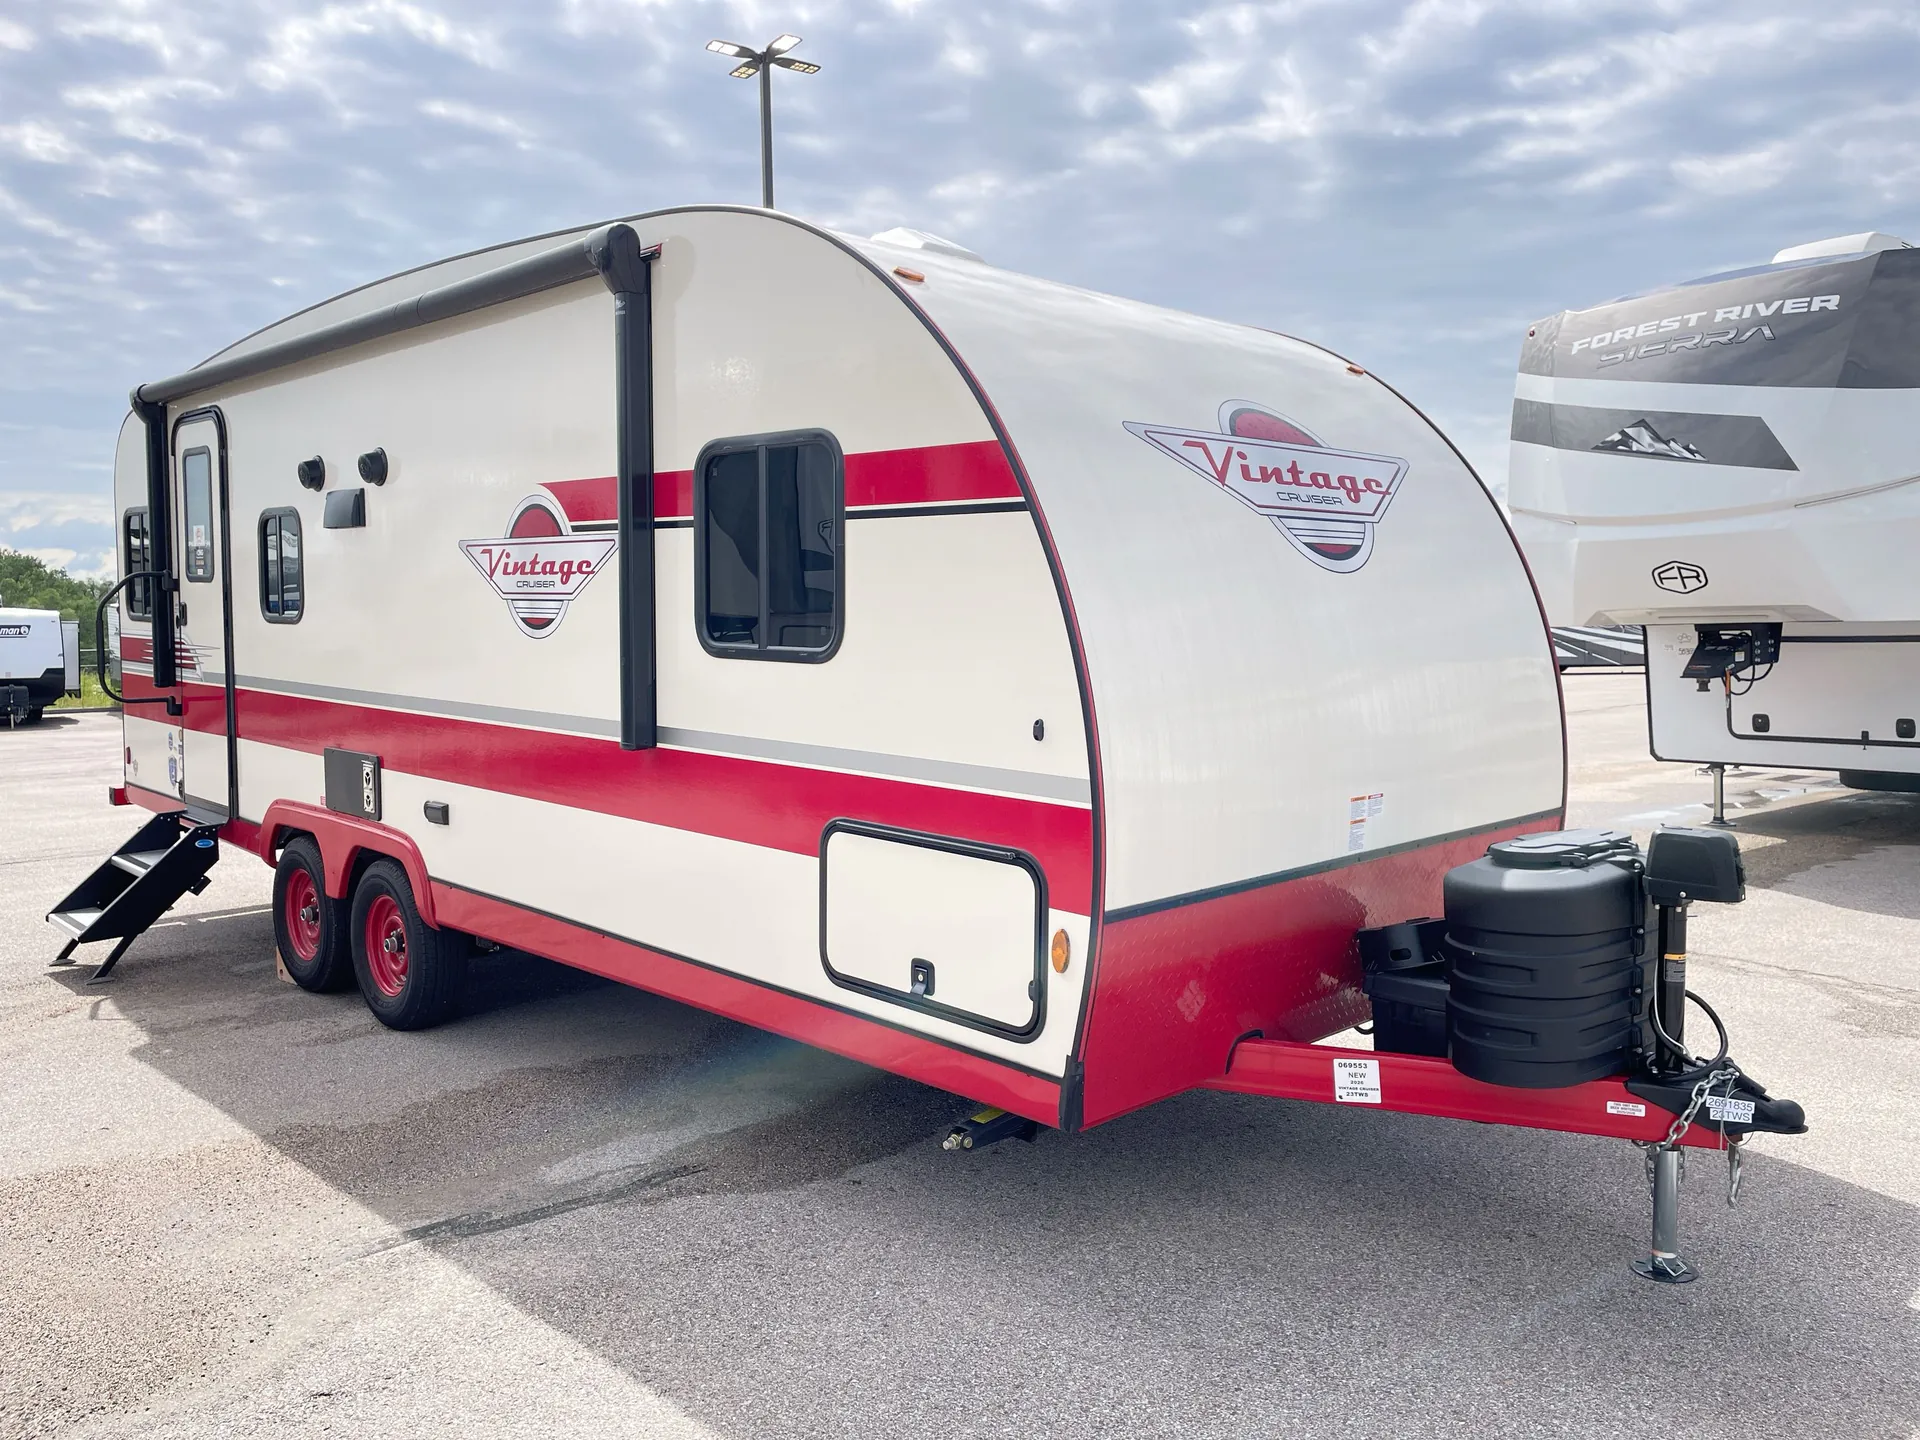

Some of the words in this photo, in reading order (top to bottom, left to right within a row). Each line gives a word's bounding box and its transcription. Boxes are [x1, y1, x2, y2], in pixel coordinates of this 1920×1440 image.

[1571, 311, 1708, 355] FOREST
[1713, 294, 1840, 323] RIVER
[1597, 322, 1776, 369] SIERRA
[1182, 440, 1392, 503] Vintage
[1276, 491, 1344, 506] CRUISER
[480, 549, 595, 585] Vintage
[516, 580, 556, 588] CRUISER
